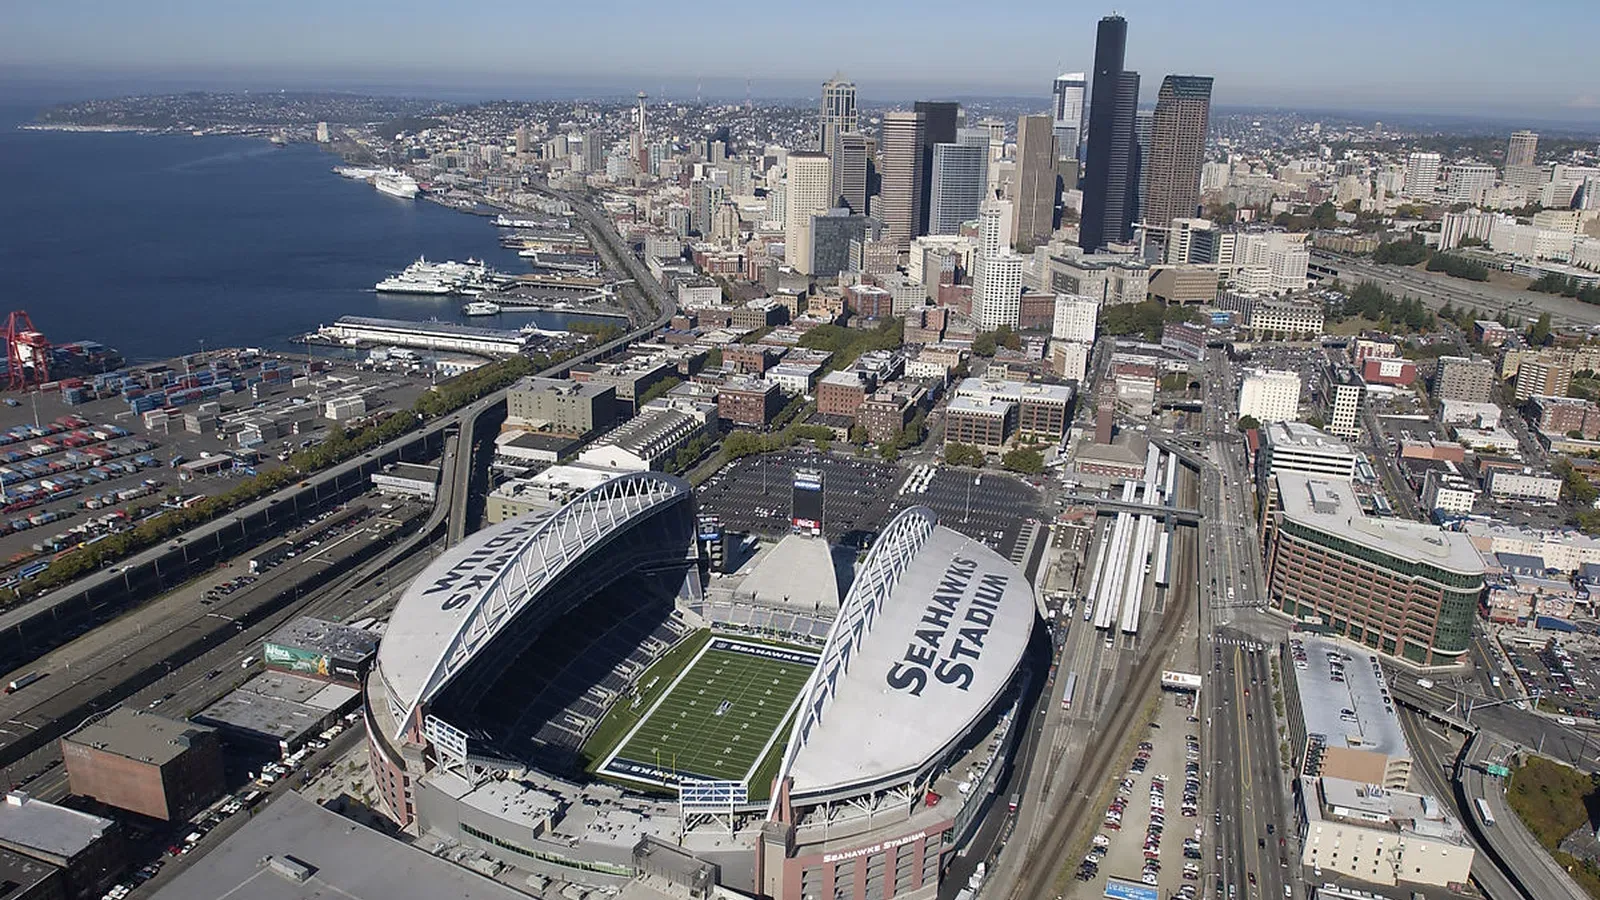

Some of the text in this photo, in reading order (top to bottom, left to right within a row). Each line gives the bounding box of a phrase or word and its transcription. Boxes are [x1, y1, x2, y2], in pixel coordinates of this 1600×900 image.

[730, 644, 801, 661] SEAHAWKS
[886, 556, 978, 697] SEAHAWKS
[934, 574, 1009, 692] STADIUM
[823, 831, 927, 863] SEAHAWKS STADIUM
